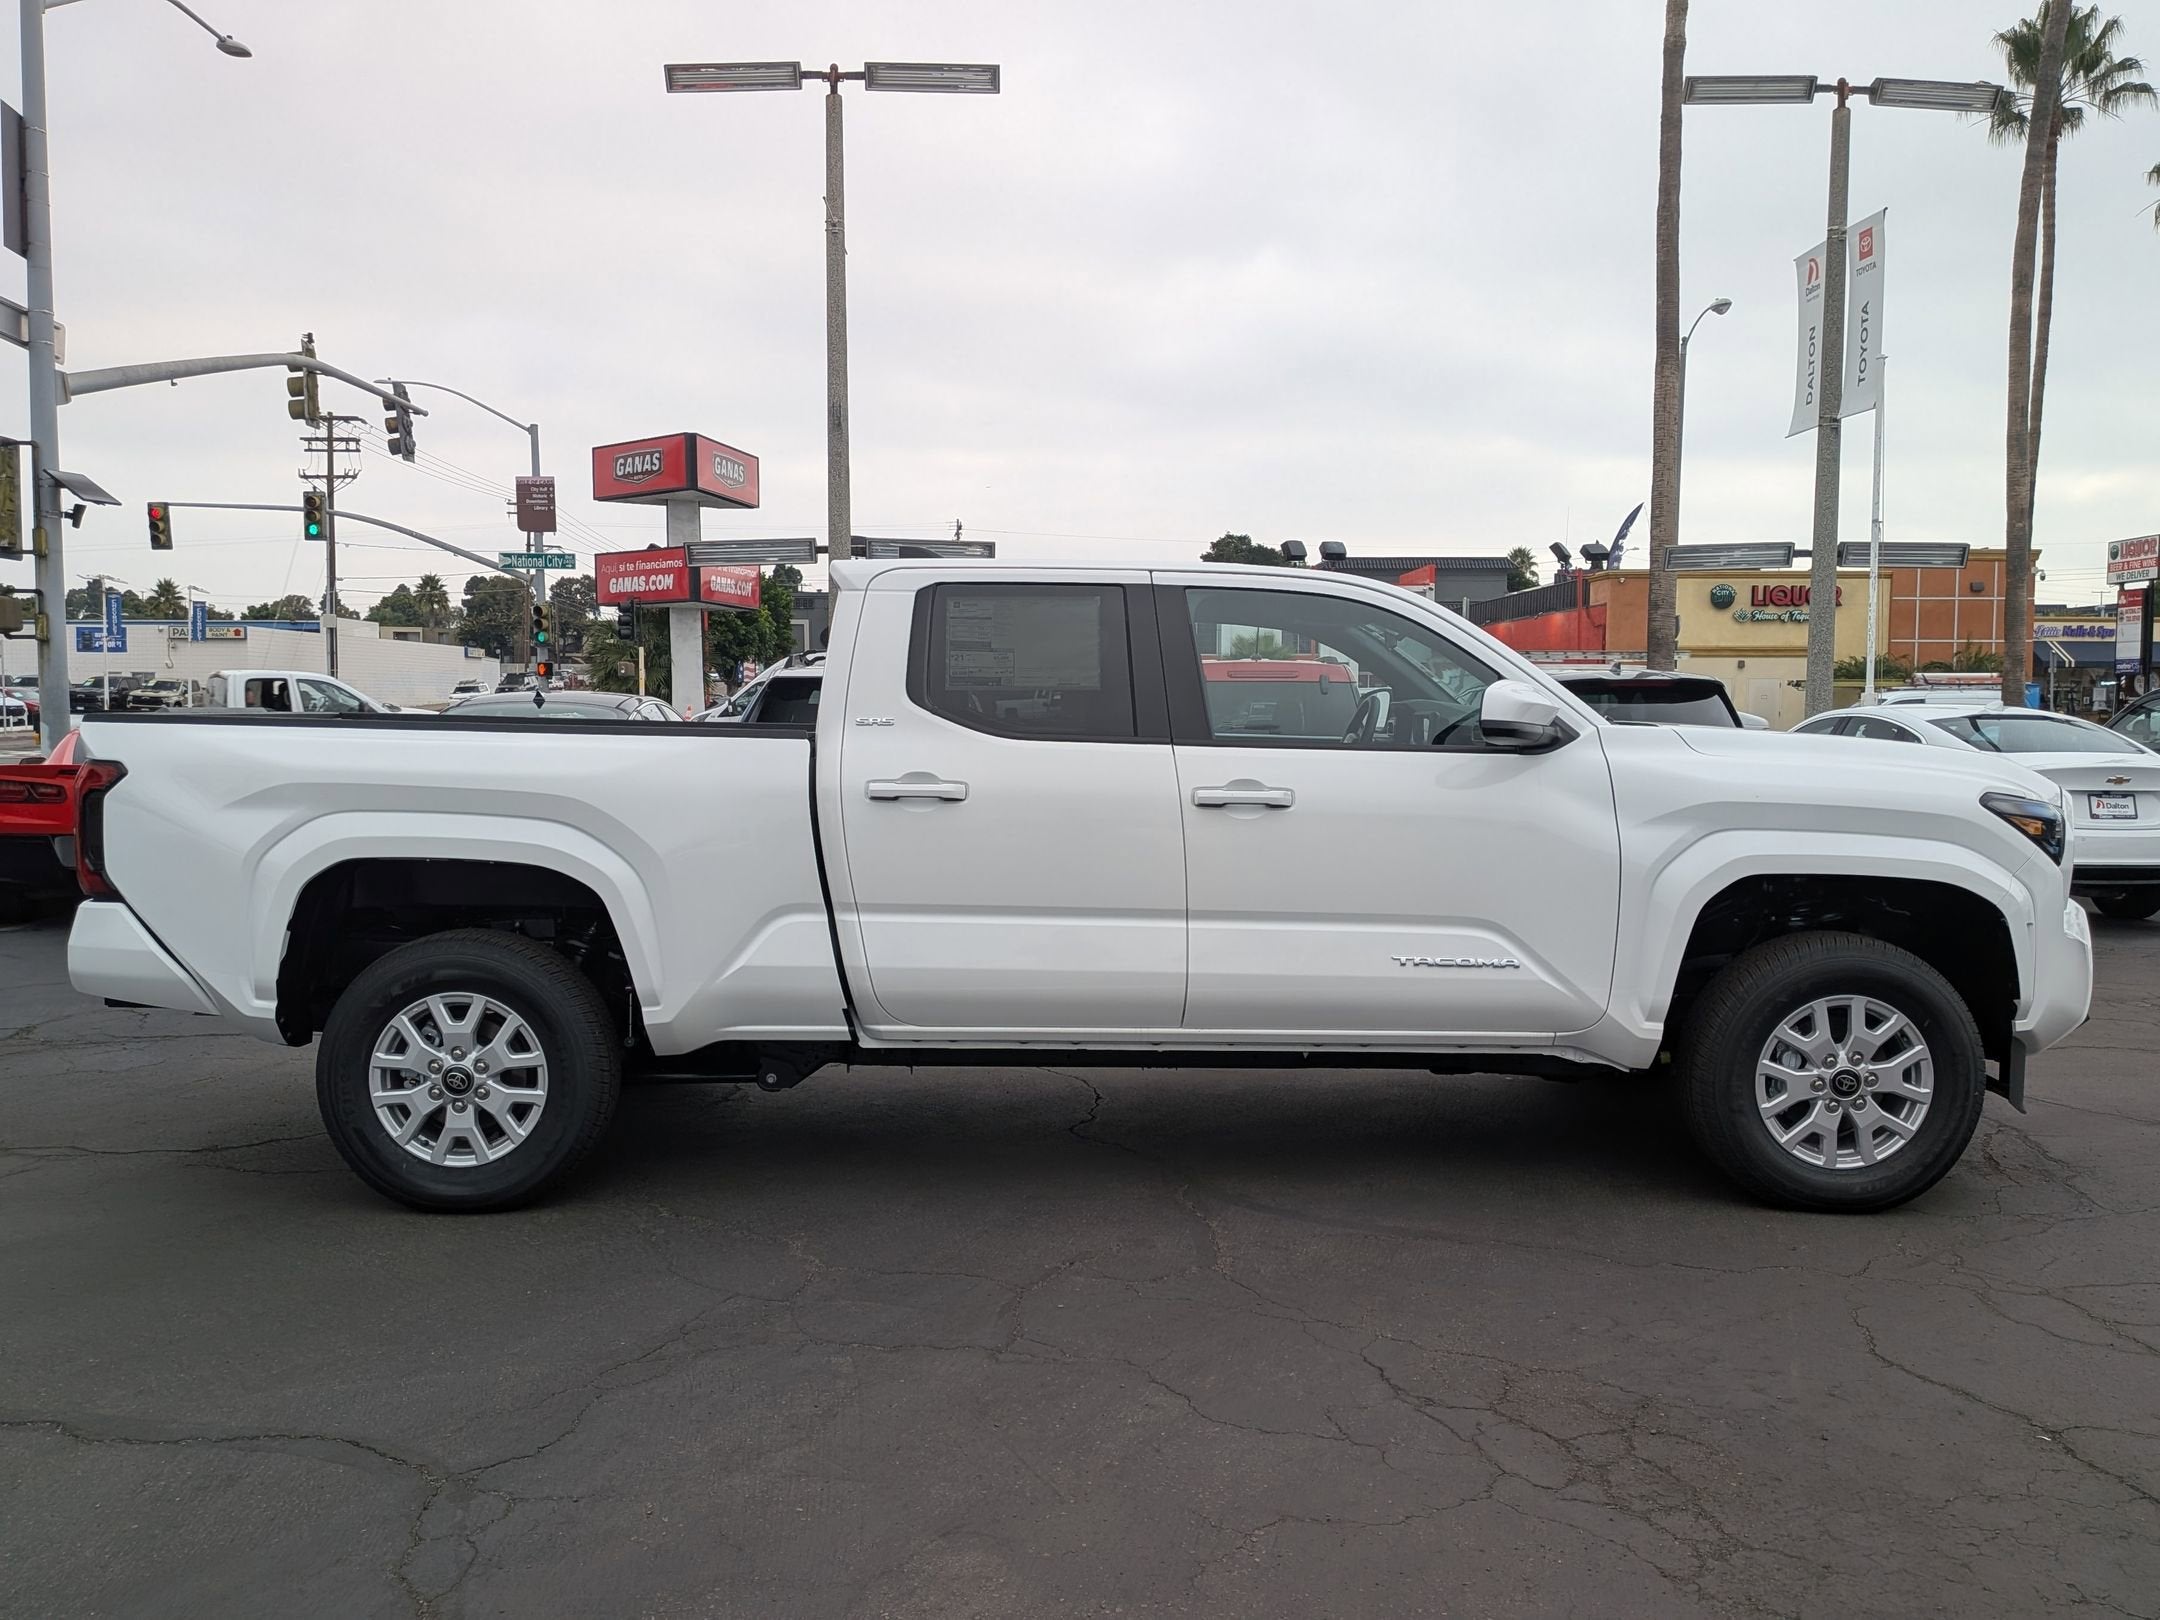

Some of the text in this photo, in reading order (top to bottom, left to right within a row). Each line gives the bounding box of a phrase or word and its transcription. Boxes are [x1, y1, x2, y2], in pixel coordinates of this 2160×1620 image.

[1856, 262, 1876, 277] TOYOTA
[1805, 283, 1820, 297] Dalton
[1857, 300, 1870, 387] TOYOTA
[1805, 325, 1816, 406] DALTON
[616, 453, 661, 476] GANAS
[714, 457, 744, 482] GANAS
[2120, 538, 2158, 560] LIQUOR
[512, 555, 545, 567] National
[547, 555, 564, 568] City
[618, 561, 626, 572] sí
[626, 562, 635, 571] te
[635, 559, 683, 571] financiamos
[2110, 558, 2157, 572] BEER & FINE WINE
[2115, 569, 2150, 581] WE DELIVER
[609, 573, 674, 594] GANAS.COM
[710, 574, 752, 597] GANAS.COM
[1751, 609, 1779, 621] House
[1780, 610, 1790, 622] of
[2096, 625, 2115, 639] Spa
[1391, 956, 1520, 968] TACOMA
